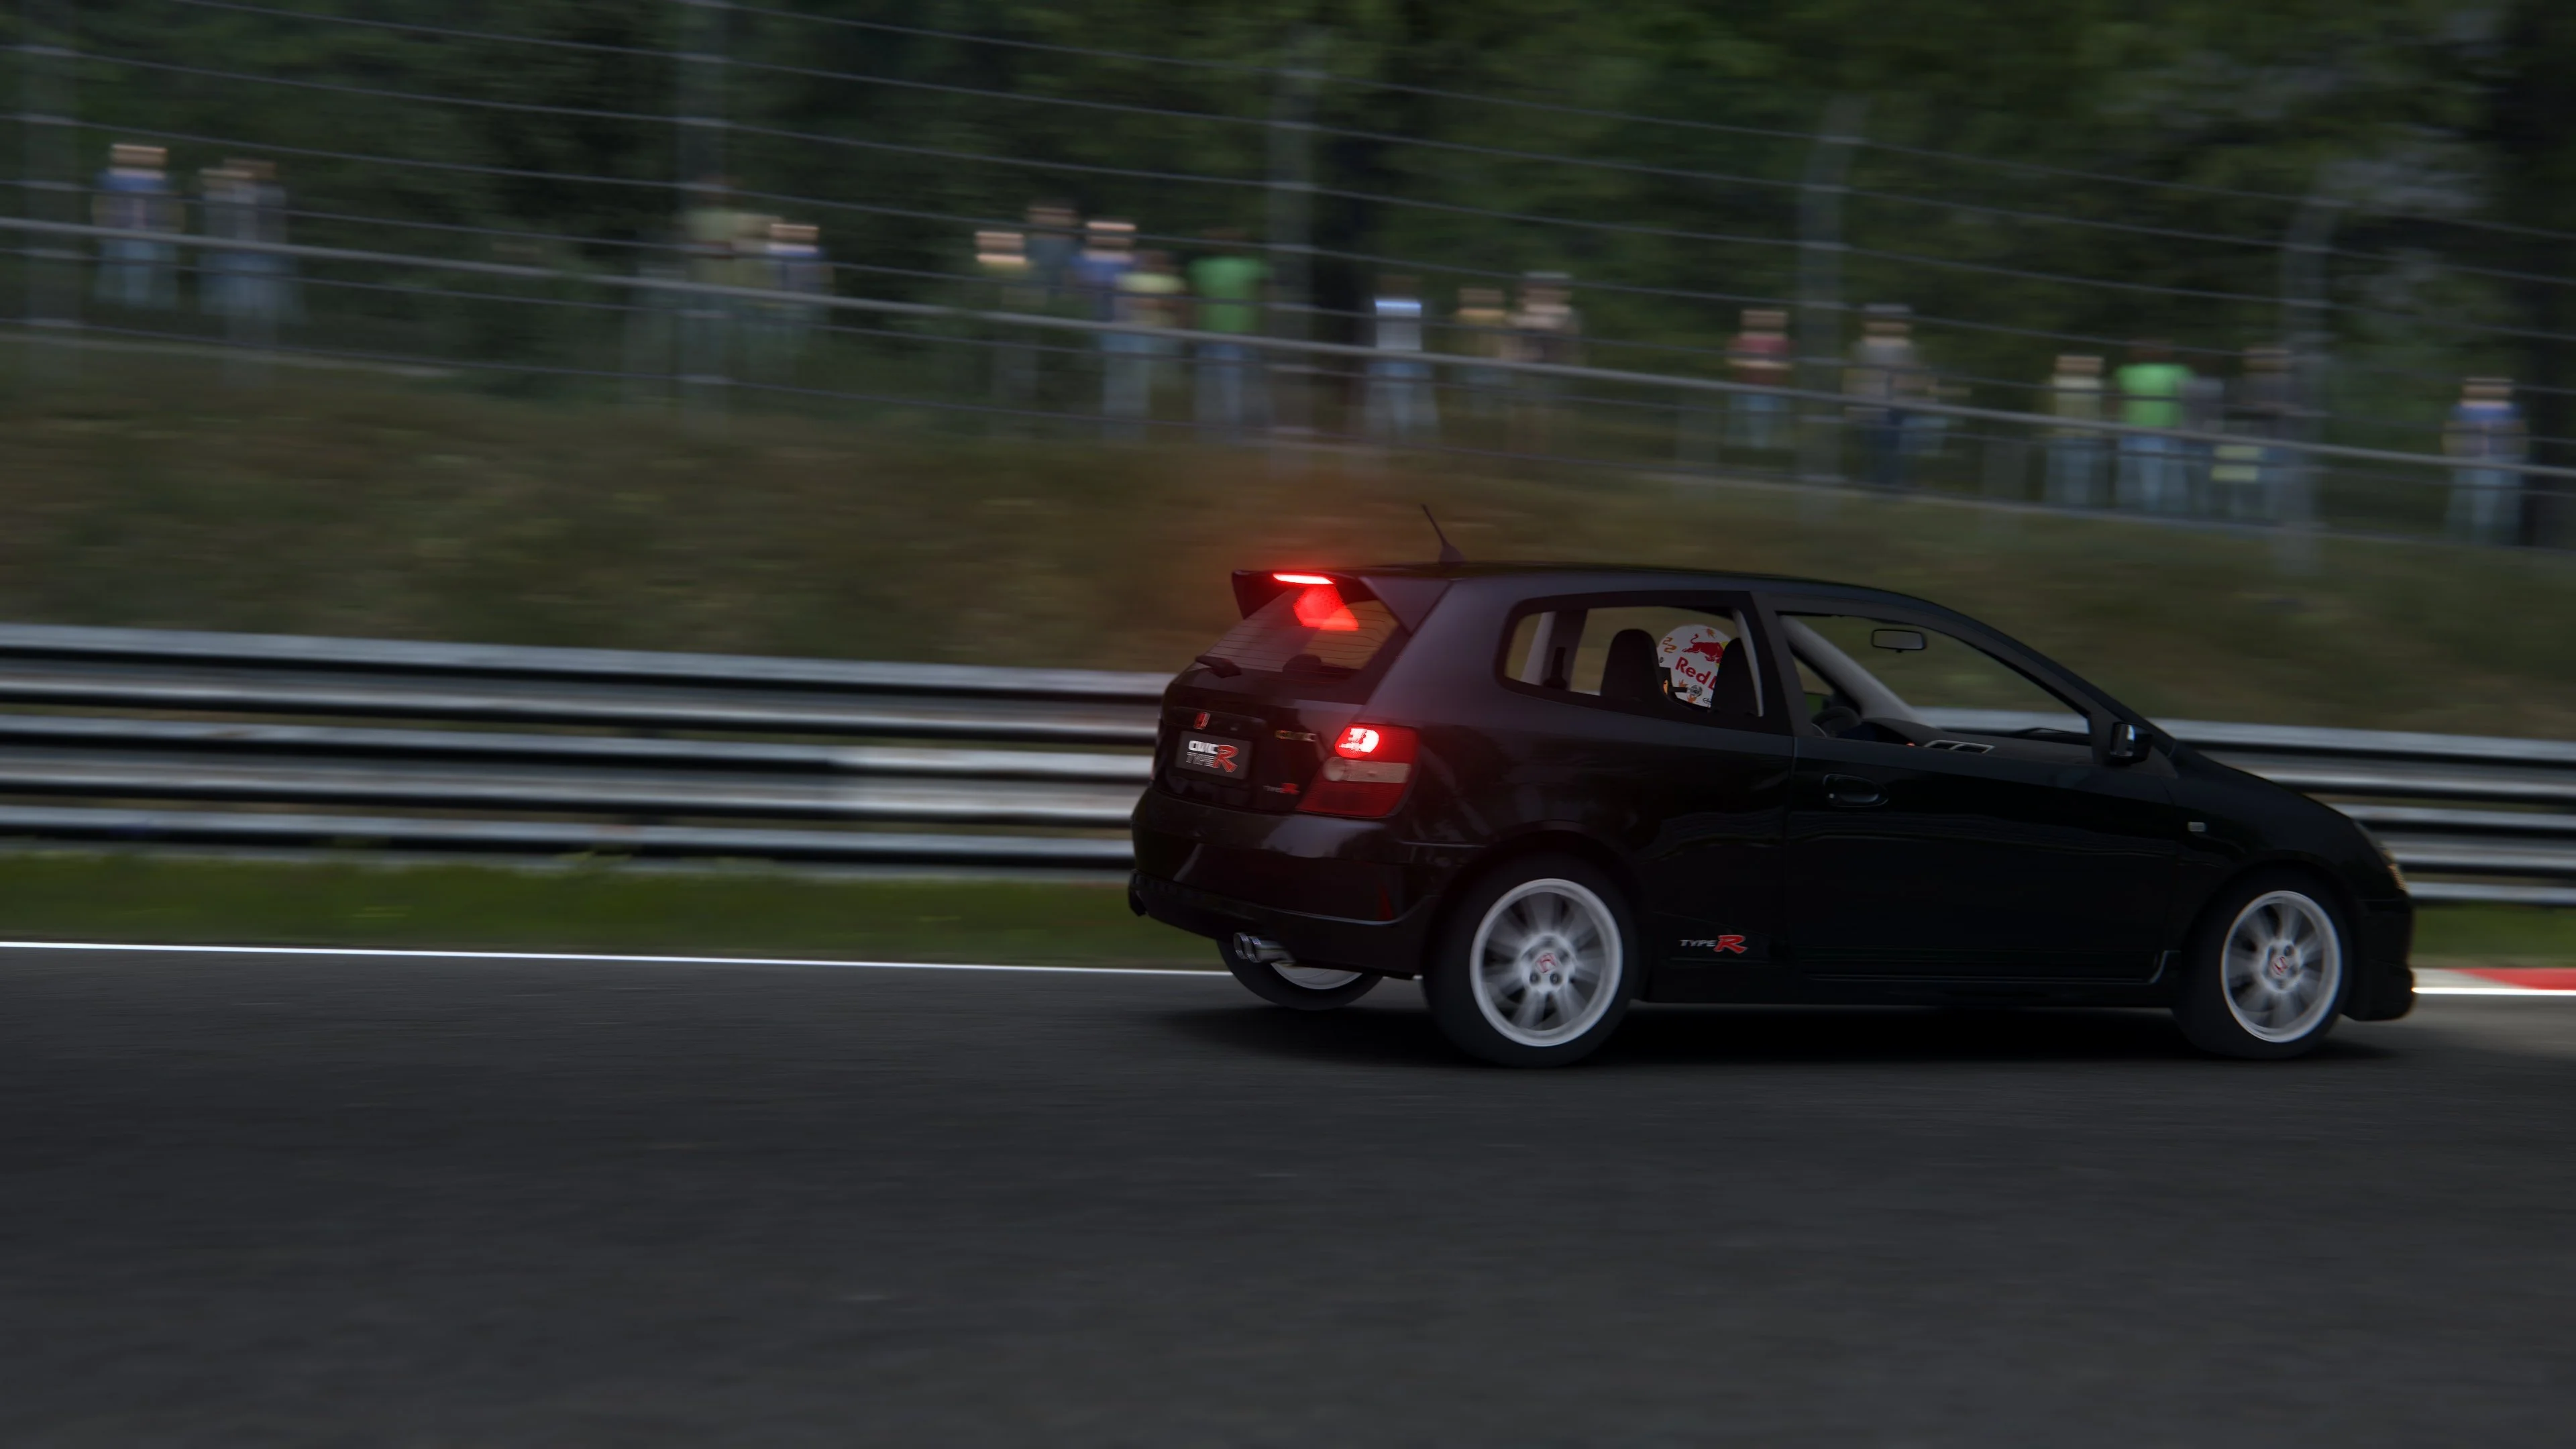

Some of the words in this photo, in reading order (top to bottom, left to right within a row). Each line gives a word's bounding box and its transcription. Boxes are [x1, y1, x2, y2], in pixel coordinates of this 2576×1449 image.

[1675, 657, 1711, 685] Red
[1213, 744, 1239, 773] R
[1713, 934, 1748, 954] R
